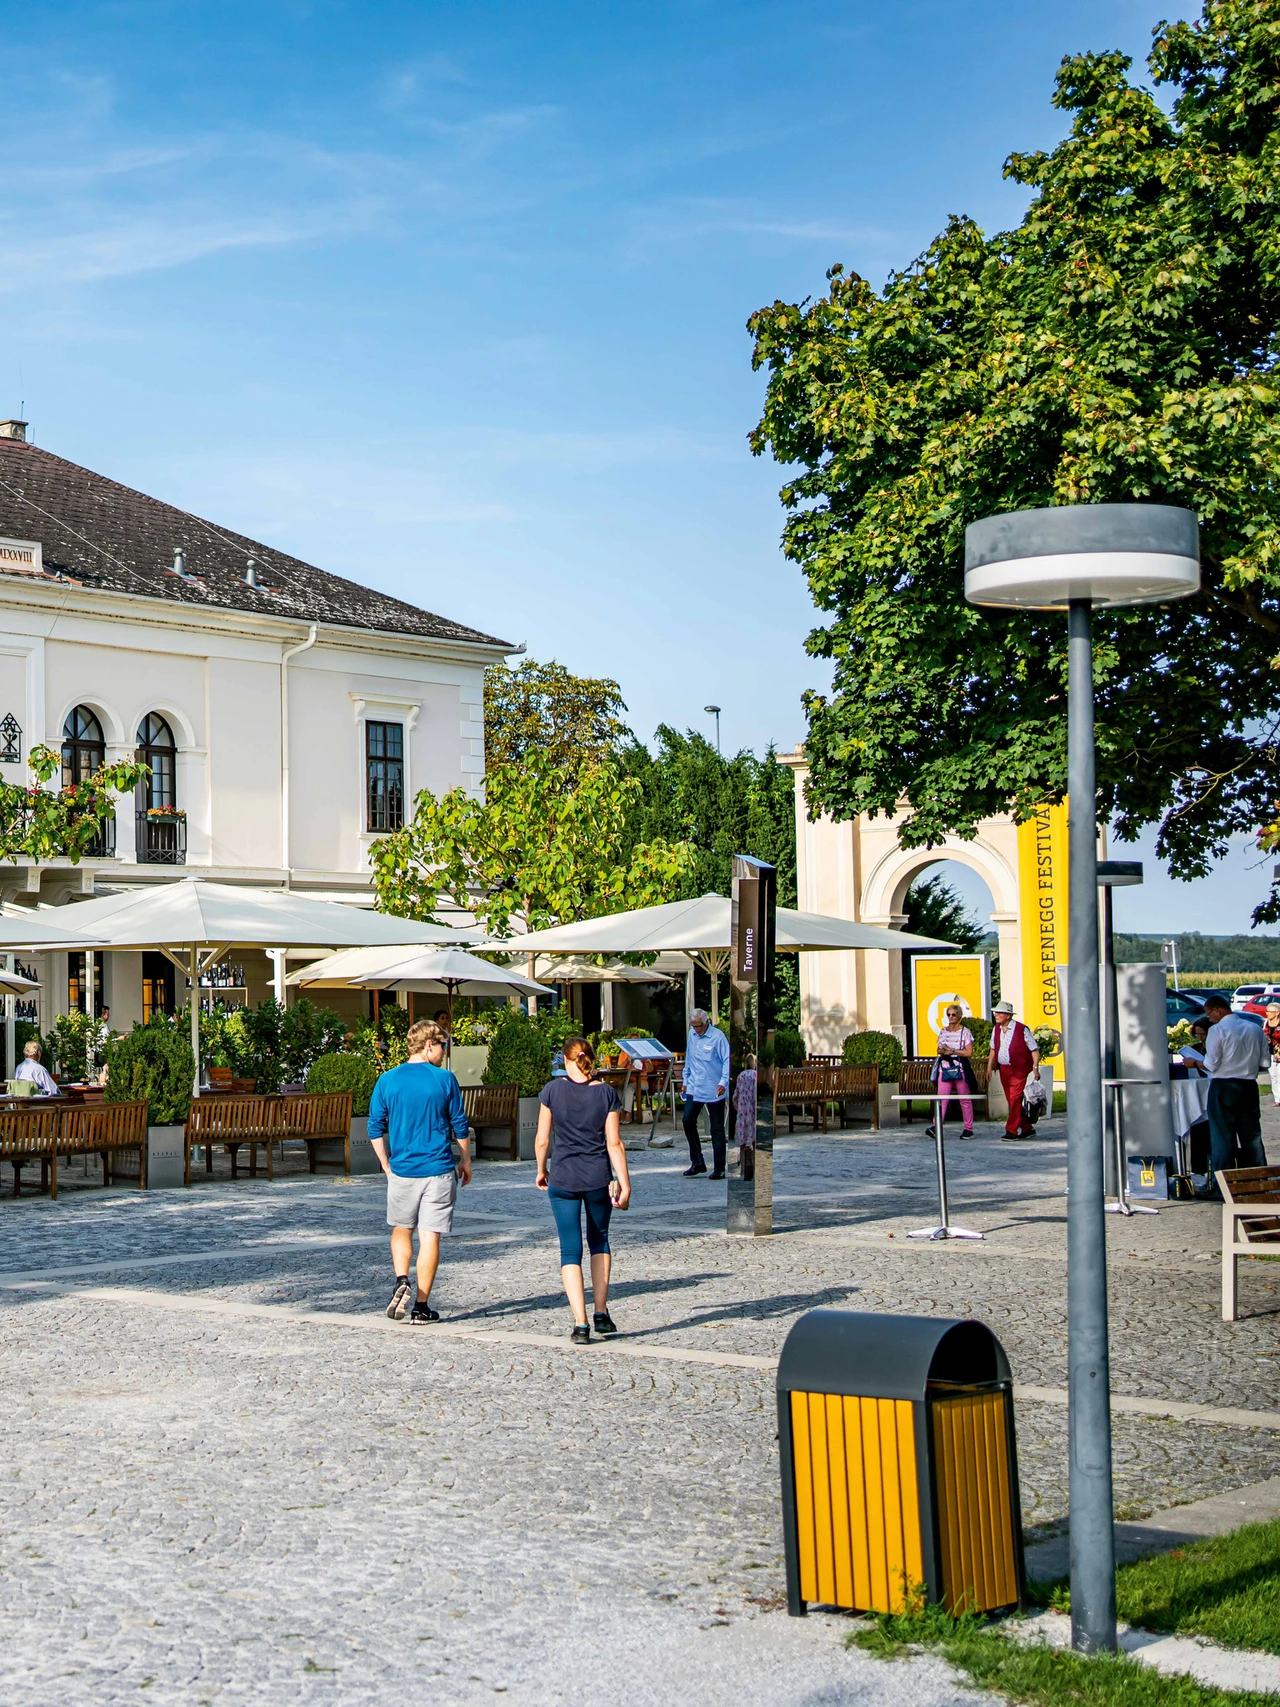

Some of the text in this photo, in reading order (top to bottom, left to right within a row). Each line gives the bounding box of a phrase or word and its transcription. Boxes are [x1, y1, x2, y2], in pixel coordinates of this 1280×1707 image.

[743, 928, 754, 972] Taverne
[1036, 806, 1058, 1016] GRAFENEGG FESTIVA
